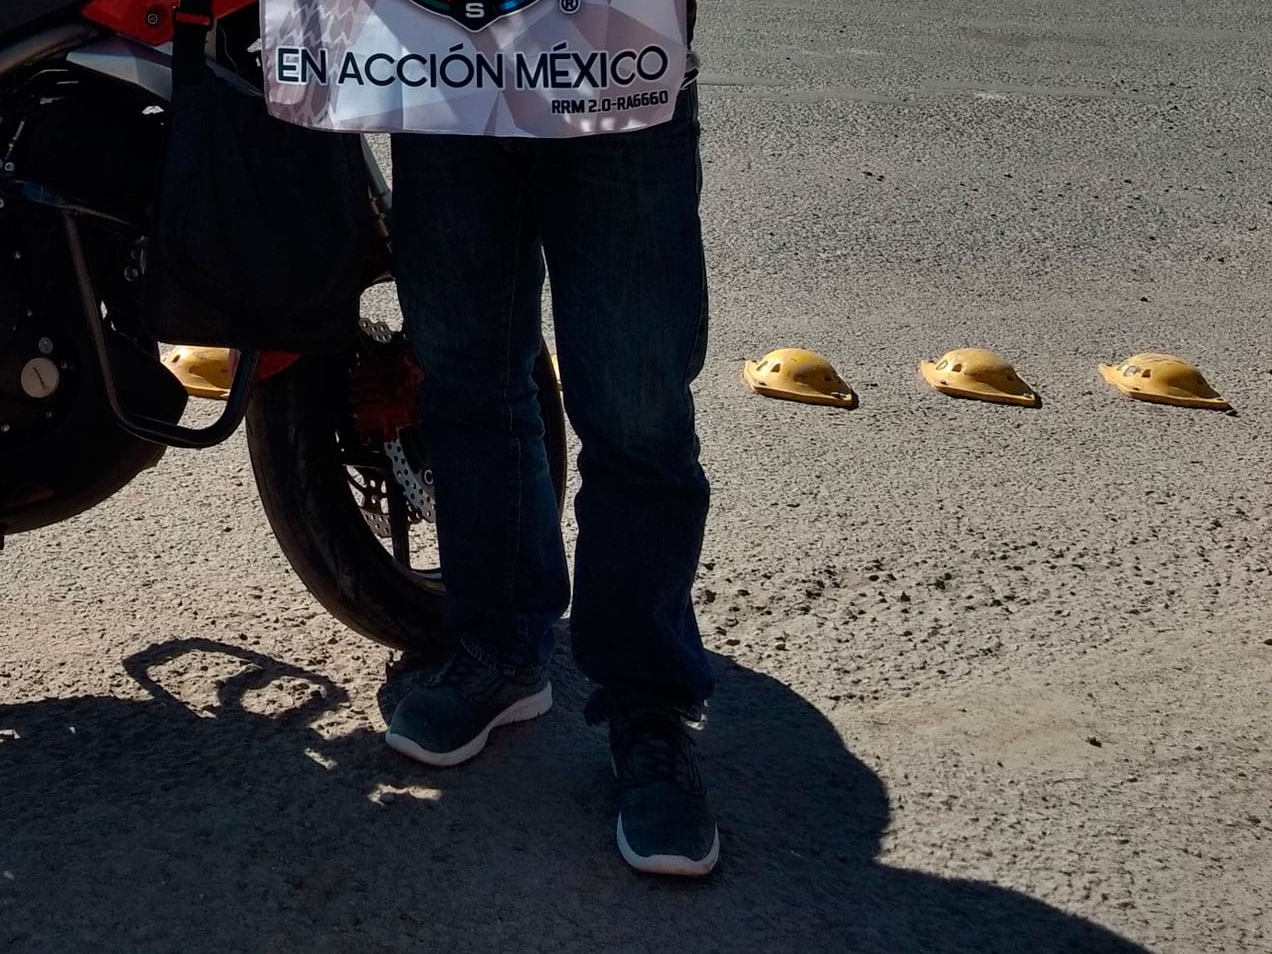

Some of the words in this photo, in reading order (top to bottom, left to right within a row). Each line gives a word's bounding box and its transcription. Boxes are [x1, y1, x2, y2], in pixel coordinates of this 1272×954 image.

[465, 3, 485, 18] S
[278, 47, 327, 84] EN
[339, 44, 503, 88] ACCIÓN
[516, 44, 668, 88] MÉXICO
[552, 100, 585, 114] RRM
[588, 90, 668, 113] 2.0-RA6660
